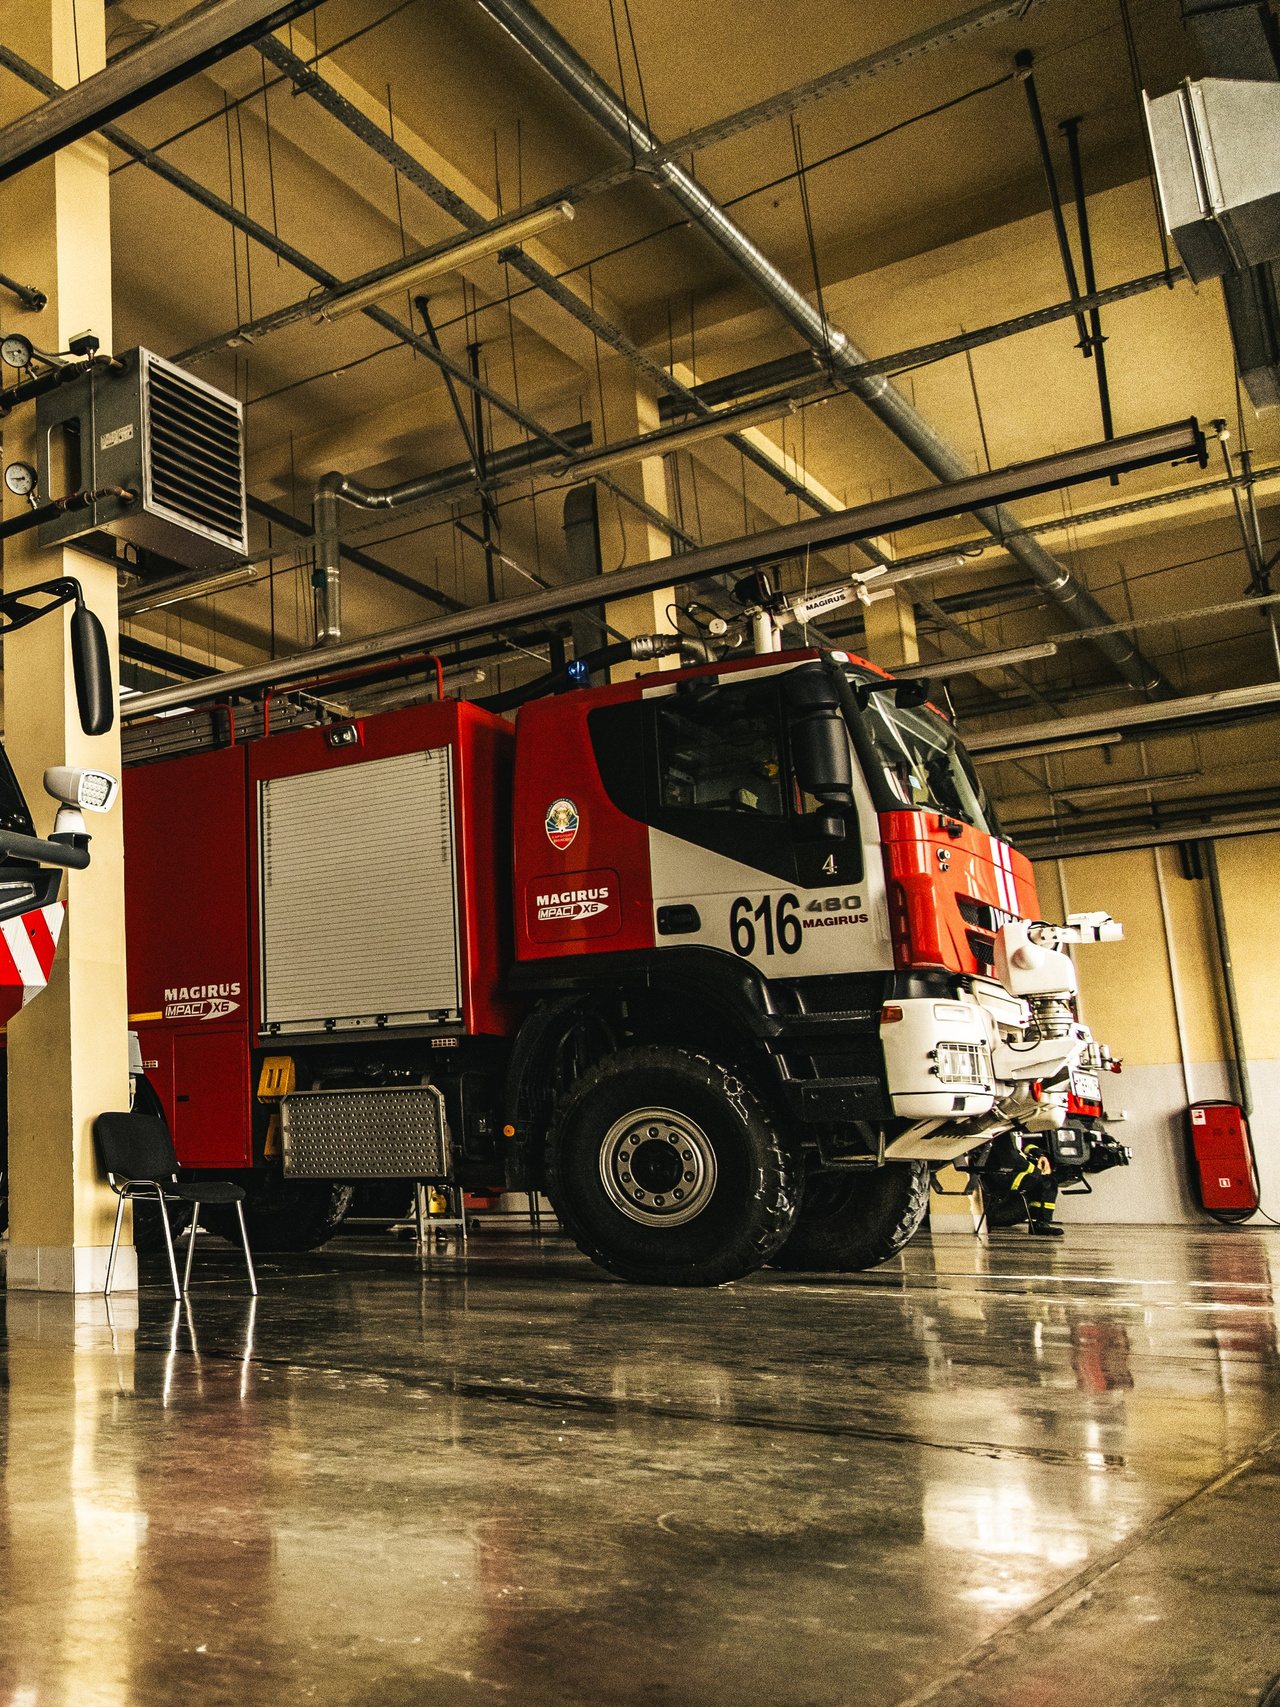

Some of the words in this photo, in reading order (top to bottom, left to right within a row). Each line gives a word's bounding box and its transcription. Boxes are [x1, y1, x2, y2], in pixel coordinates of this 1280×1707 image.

[806, 594, 846, 611] MAGIRUS
[536, 887, 609, 906] MAGIRUS
[805, 895, 862, 913] 480
[538, 903, 577, 919] IMPACT
[582, 903, 599, 914] X6
[730, 893, 803, 958] 616
[803, 914, 869, 929] MAGIRUS
[164, 982, 241, 1001] MAGIRUS
[165, 1002, 208, 1017] IMPACT
[212, 1001, 230, 1013] X6
